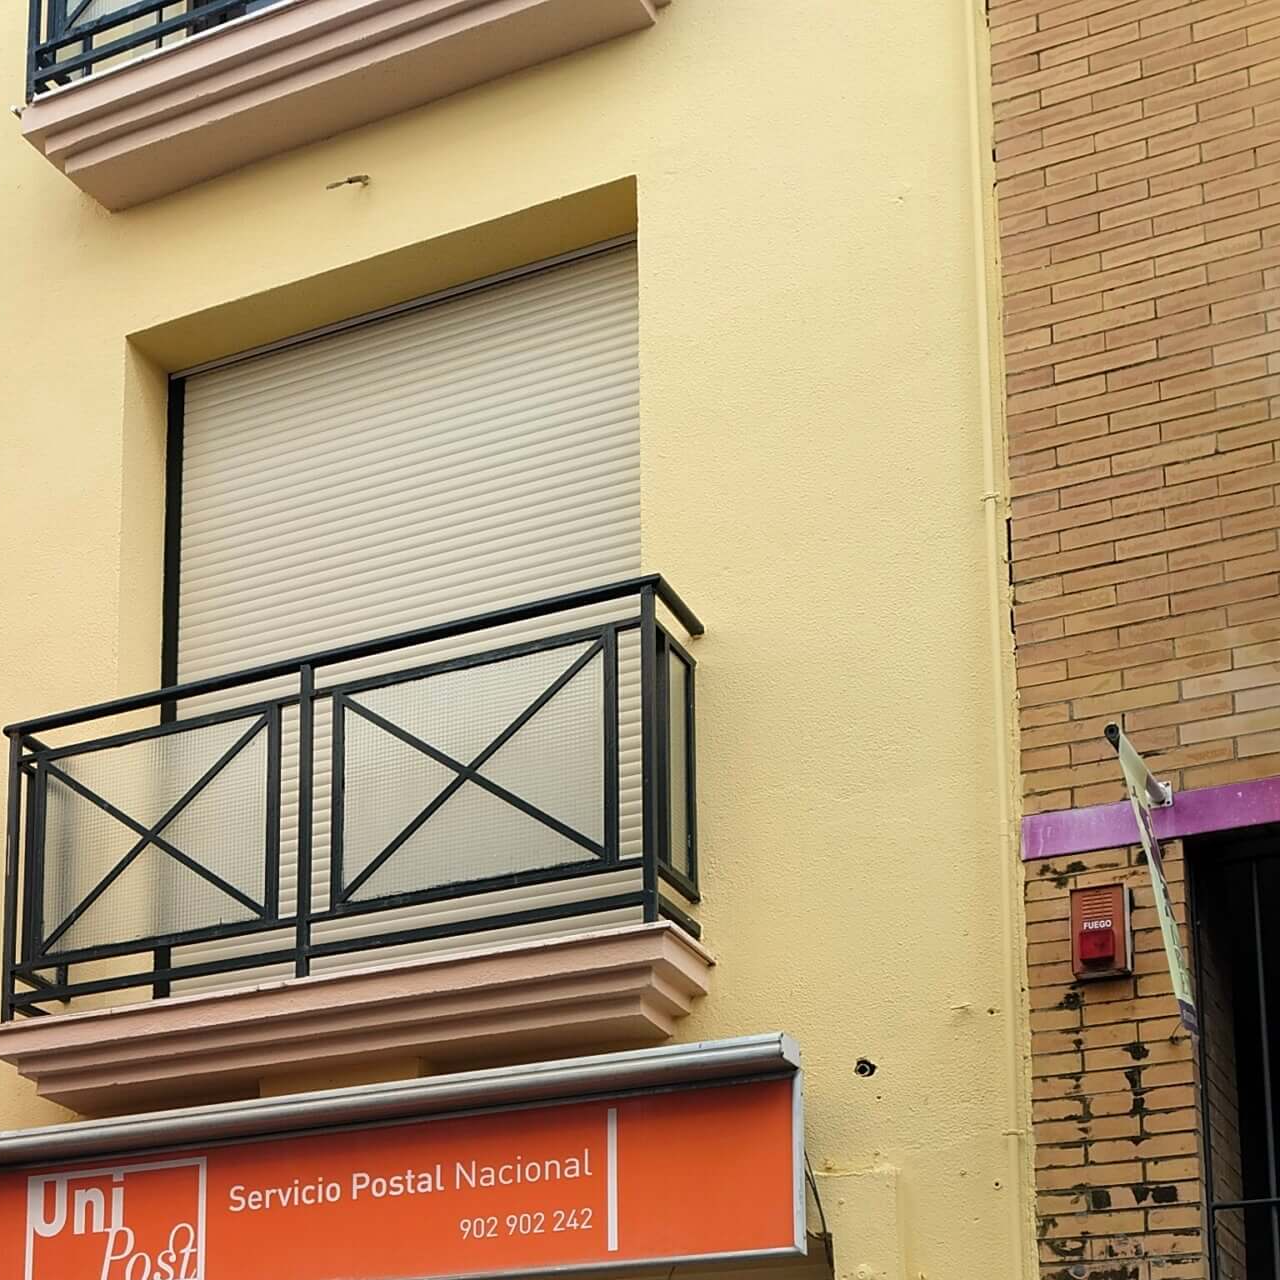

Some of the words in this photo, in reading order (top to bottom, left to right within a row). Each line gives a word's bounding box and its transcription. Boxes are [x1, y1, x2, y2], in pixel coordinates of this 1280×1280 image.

[1083, 919, 1112, 930] FUEGO
[28, 1170, 124, 1238] Uni
[229, 1176, 341, 1212] Servicio
[351, 1164, 445, 1201] Postal
[455, 1148, 593, 1190] Nacional
[459, 1216, 499, 1240] 902
[505, 1211, 546, 1236] 902
[552, 1207, 593, 1232] 242
